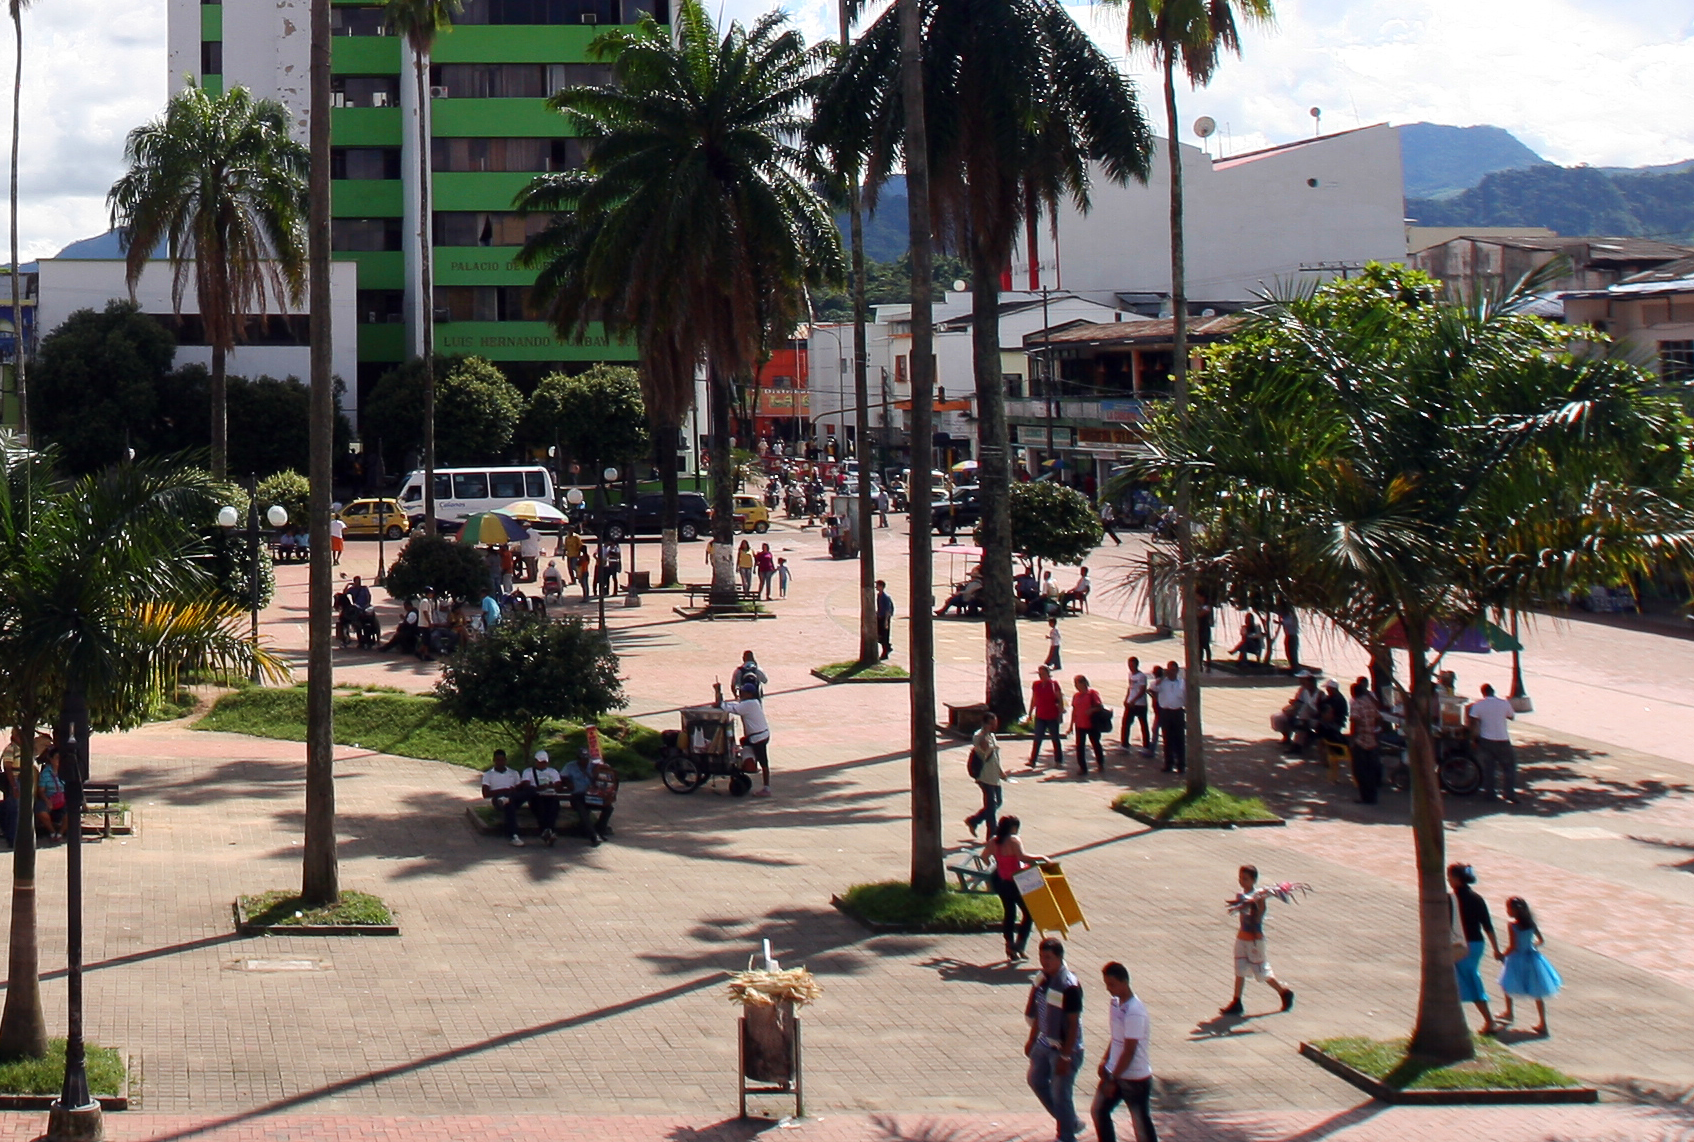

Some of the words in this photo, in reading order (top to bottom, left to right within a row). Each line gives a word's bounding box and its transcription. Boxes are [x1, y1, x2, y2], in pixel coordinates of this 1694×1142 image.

[450, 261, 499, 271] PALACIO
[443, 336, 474, 347] LUIS
[480, 336, 550, 347] HERNANDO
